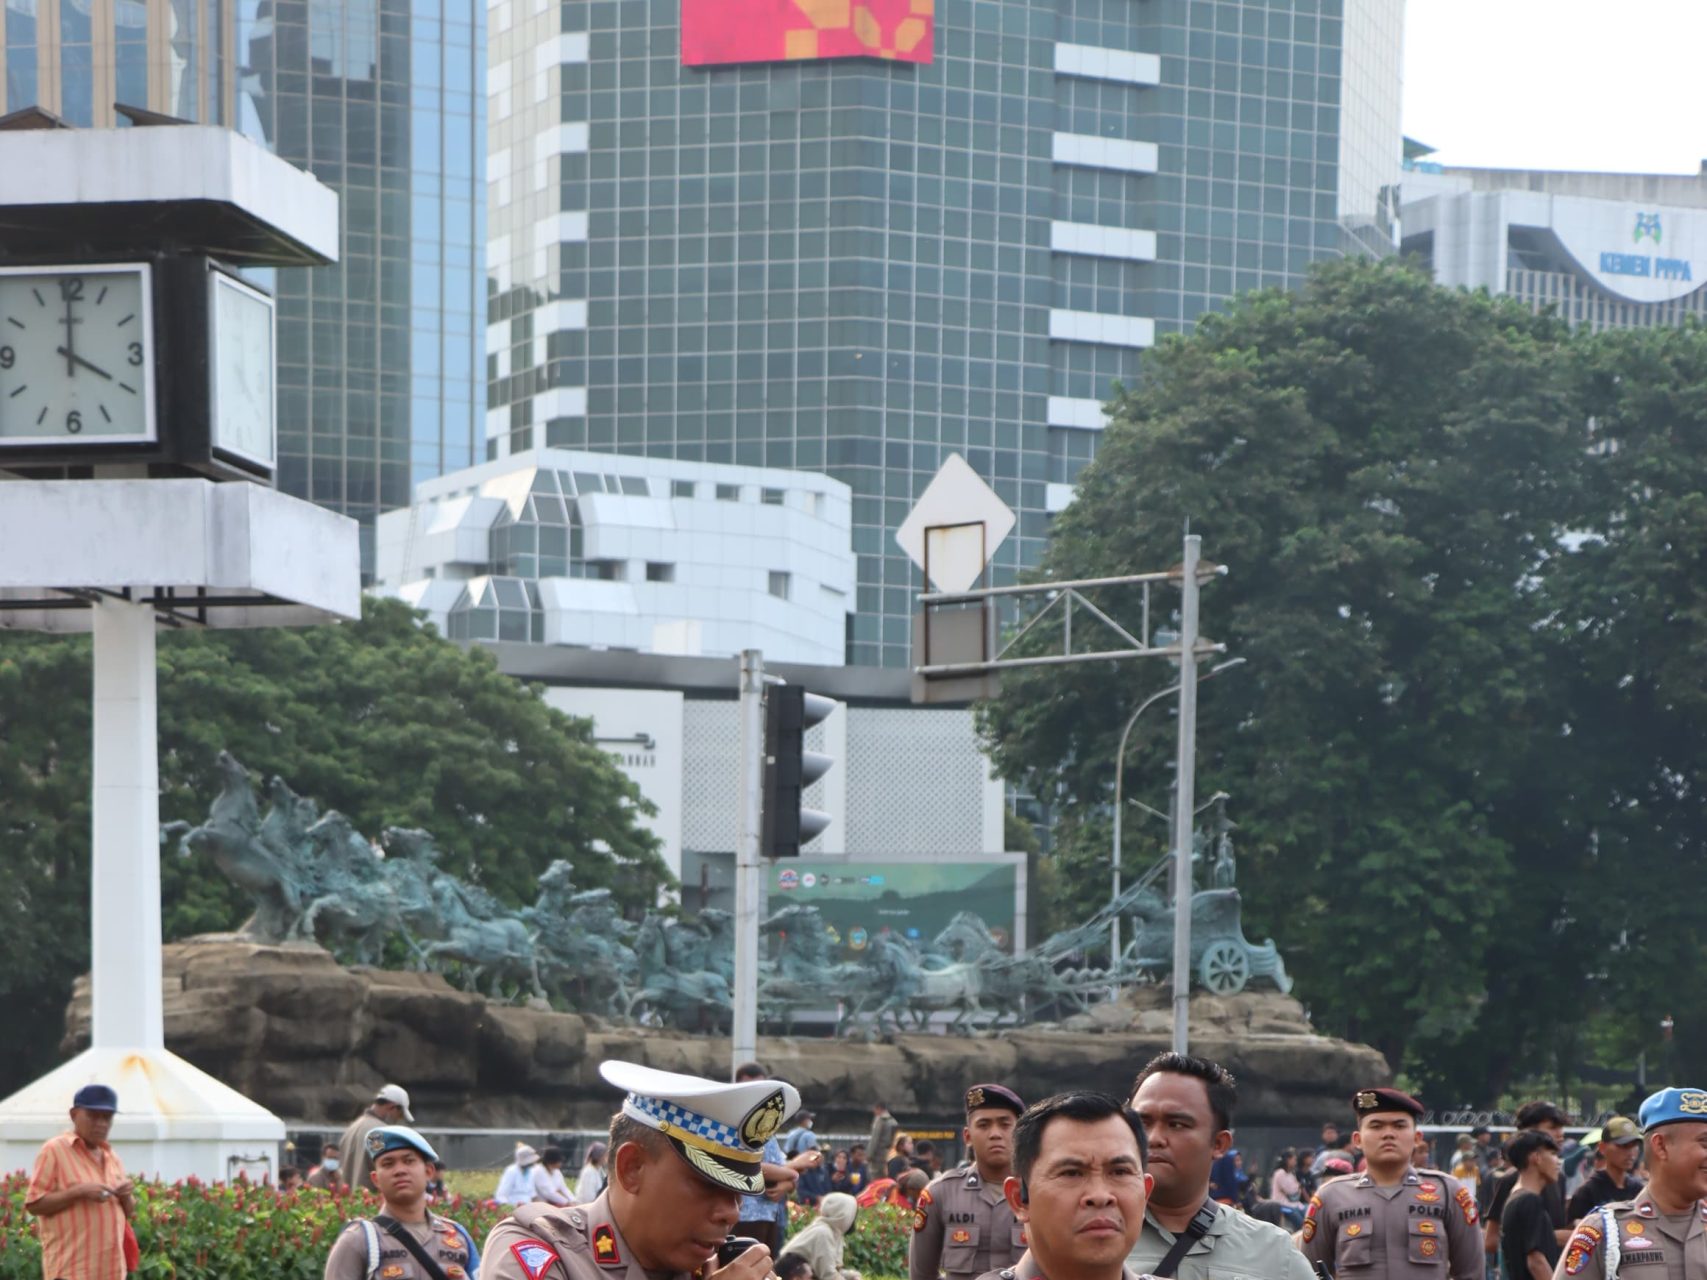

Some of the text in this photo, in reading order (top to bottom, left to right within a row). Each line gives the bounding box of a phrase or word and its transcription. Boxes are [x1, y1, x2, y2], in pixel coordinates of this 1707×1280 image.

[58, 278, 85, 302] 12
[0, 345, 15, 370] 9
[127, 341, 144, 367] 3
[65, 410, 82, 434] 6
[948, 1213, 975, 1223] ALDI
